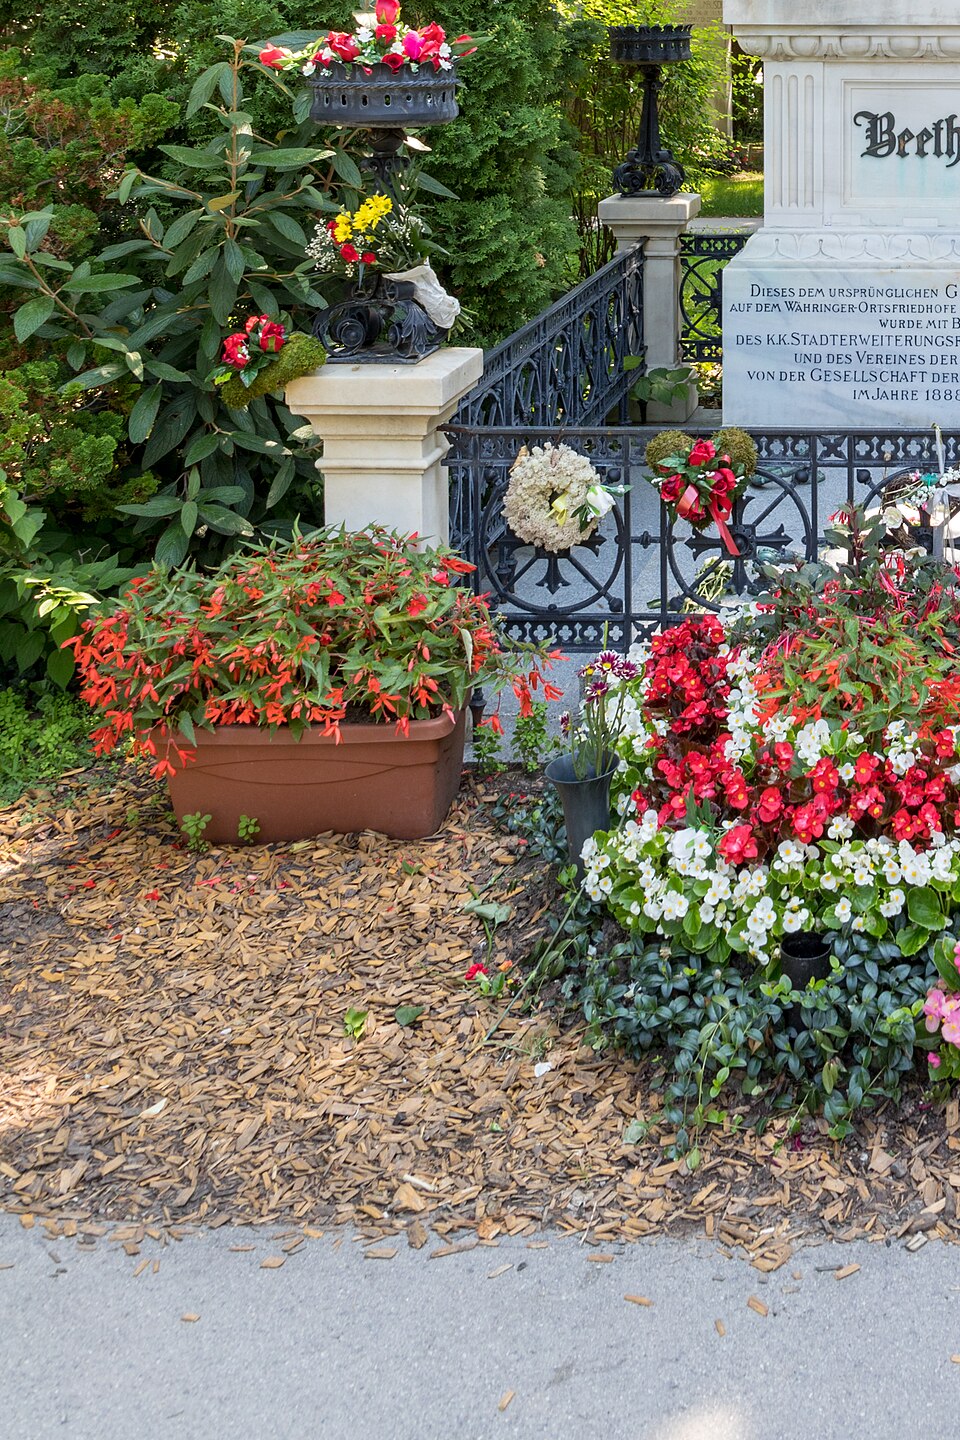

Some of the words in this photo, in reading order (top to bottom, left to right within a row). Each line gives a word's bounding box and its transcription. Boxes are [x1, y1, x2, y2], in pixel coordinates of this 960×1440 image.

[750, 283, 796, 298] DIESES
[798, 287, 826, 298] DEM
[828, 285, 939, 299] URSPRÜNGLICHEN
[729, 302, 753, 313] AUF
[755, 302, 782, 313] DEM
[878, 317, 924, 330] WURDE
[925, 319, 949, 330] MIT
[735, 334, 763, 346] DES
[794, 352, 823, 365] UND
[825, 353, 853, 365] DES
[855, 350, 926, 366] VEREINES
[929, 354, 959, 366] DER
[746, 370, 776, 382] VON
[778, 370, 806, 382] DER
[809, 367, 928, 383] GESELLSCHAFT
[931, 372, 960, 384] DER
[853, 389, 870, 400] IM
[871, 387, 919, 401] JAHRE
